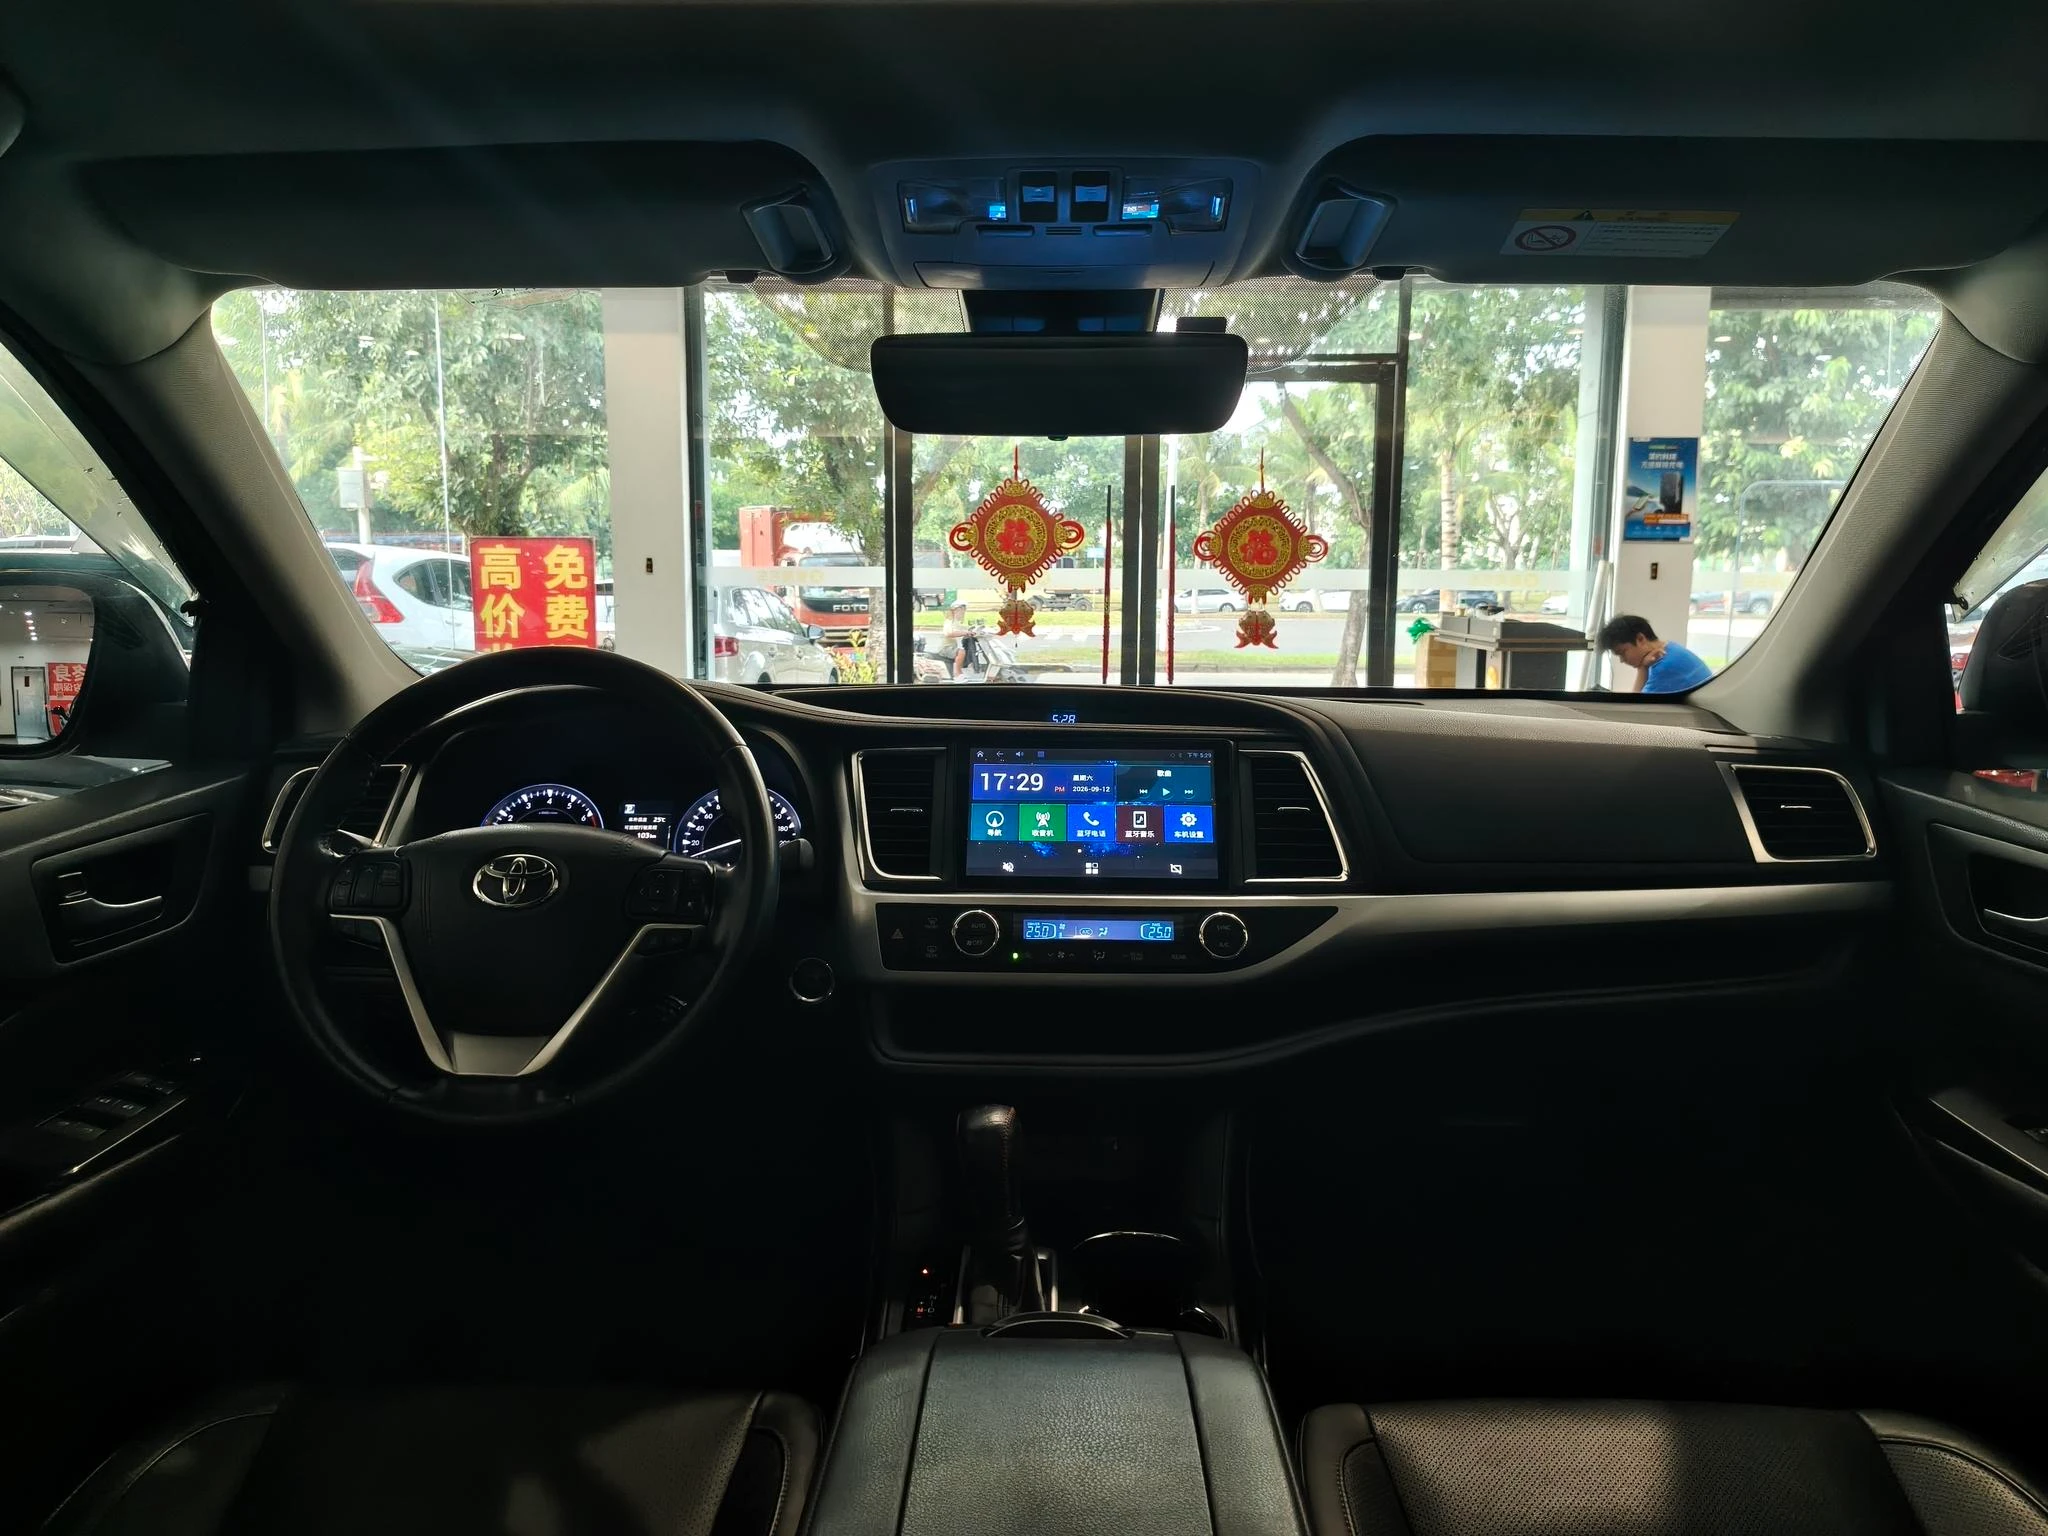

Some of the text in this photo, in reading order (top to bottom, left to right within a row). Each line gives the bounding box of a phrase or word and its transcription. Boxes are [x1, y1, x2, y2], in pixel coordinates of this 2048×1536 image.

[479, 544, 525, 651] 高价
[543, 544, 589, 648] 免费
[832, 604, 868, 612] FOTO
[980, 772, 1044, 791] 17:29
[1076, 830, 1106, 838] 蓝牙电话
[1125, 830, 1155, 838] 蓝牙音乐
